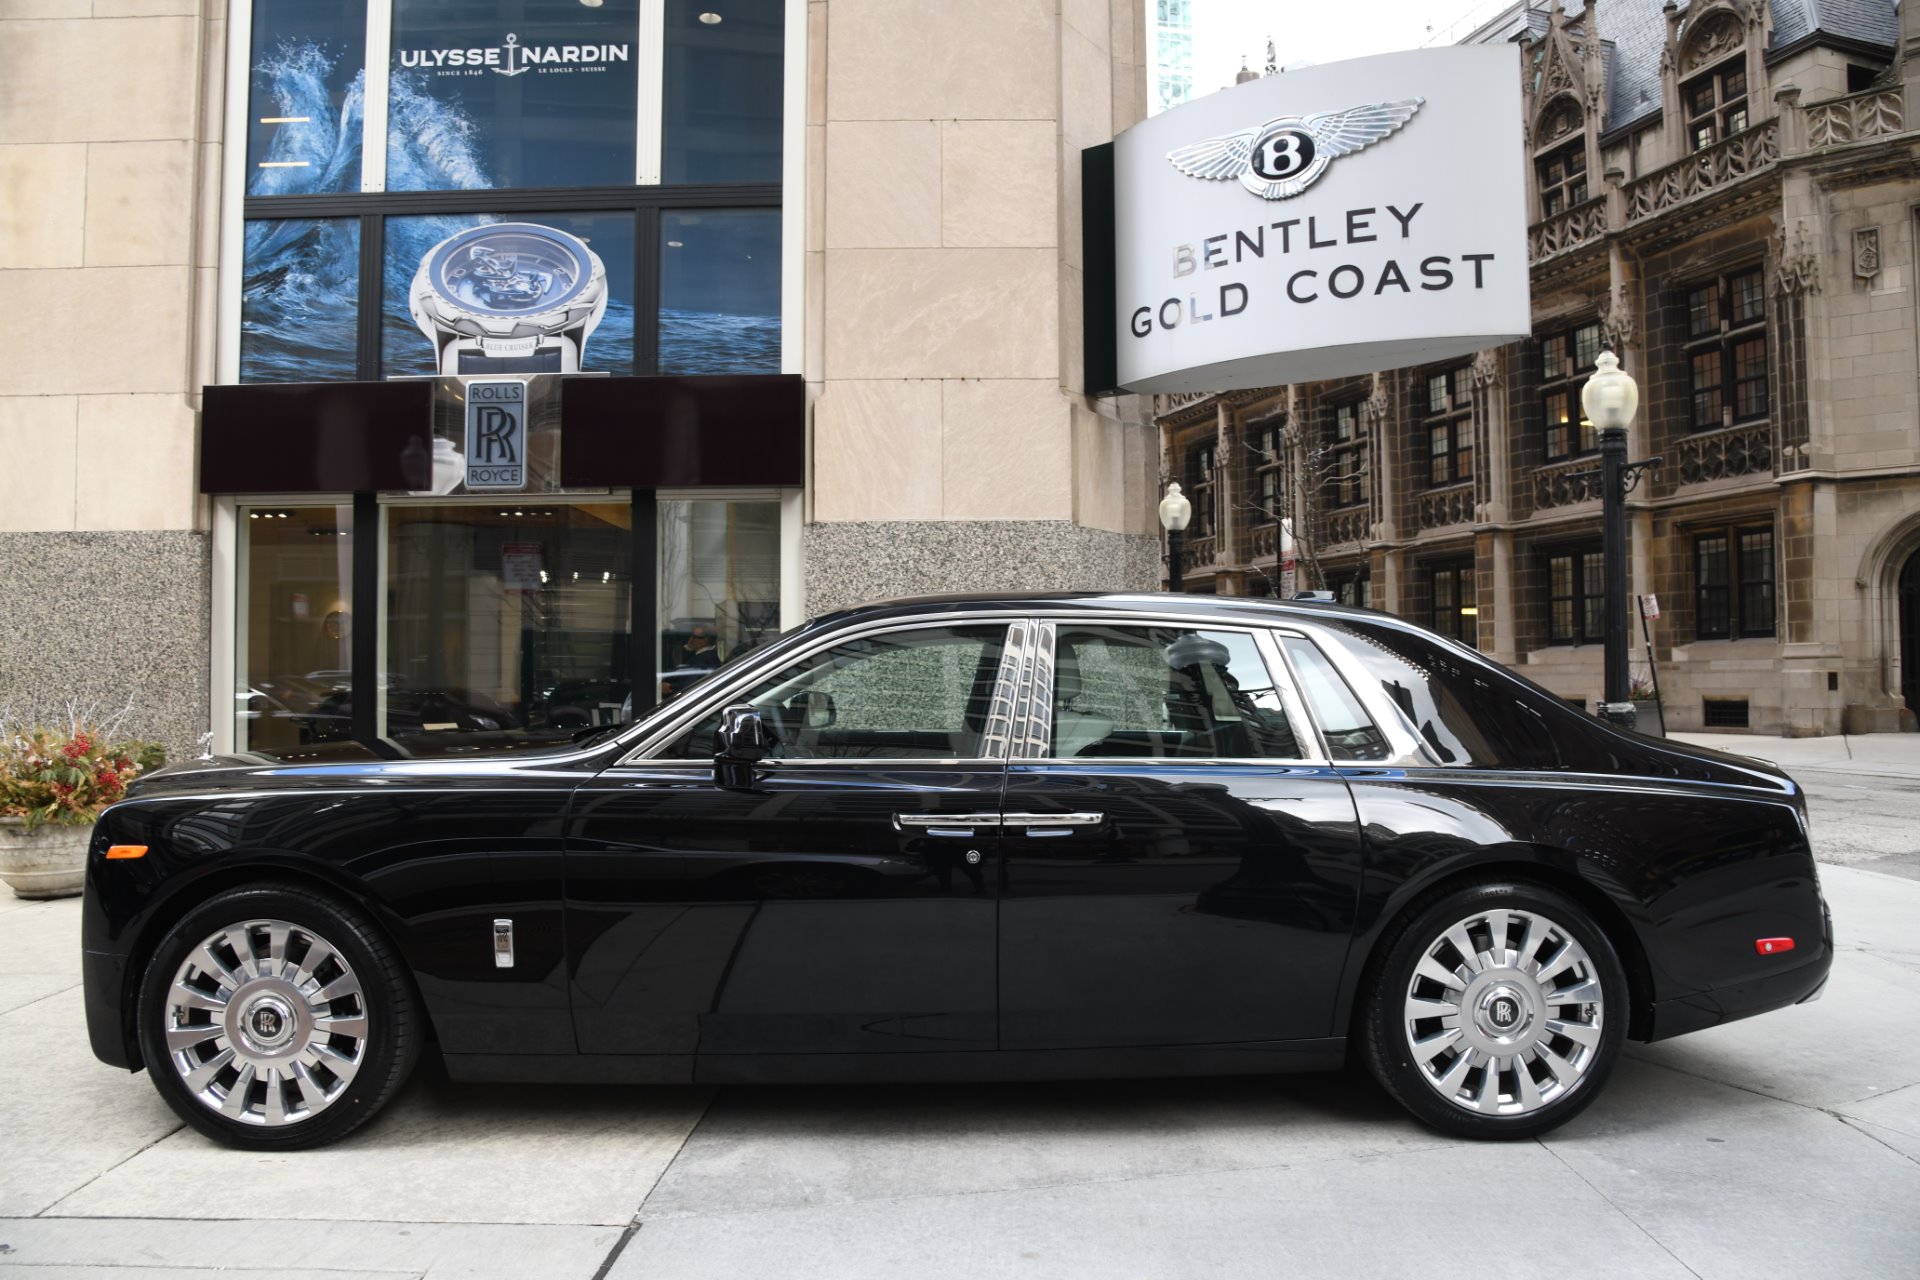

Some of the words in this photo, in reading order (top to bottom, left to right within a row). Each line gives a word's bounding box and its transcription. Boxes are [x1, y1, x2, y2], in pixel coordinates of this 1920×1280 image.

[400, 48, 501, 67] ULYSSE
[521, 44, 628, 64] NARDIN
[464, 69, 483, 77] 1846
[1262, 134, 1303, 176] B
[1172, 202, 1425, 279] BENTLEY
[1130, 282, 1249, 338] GOLD
[1286, 253, 1495, 304] COAST
[472, 387, 520, 399] ROLLS
[470, 469, 519, 482] ROYCE
